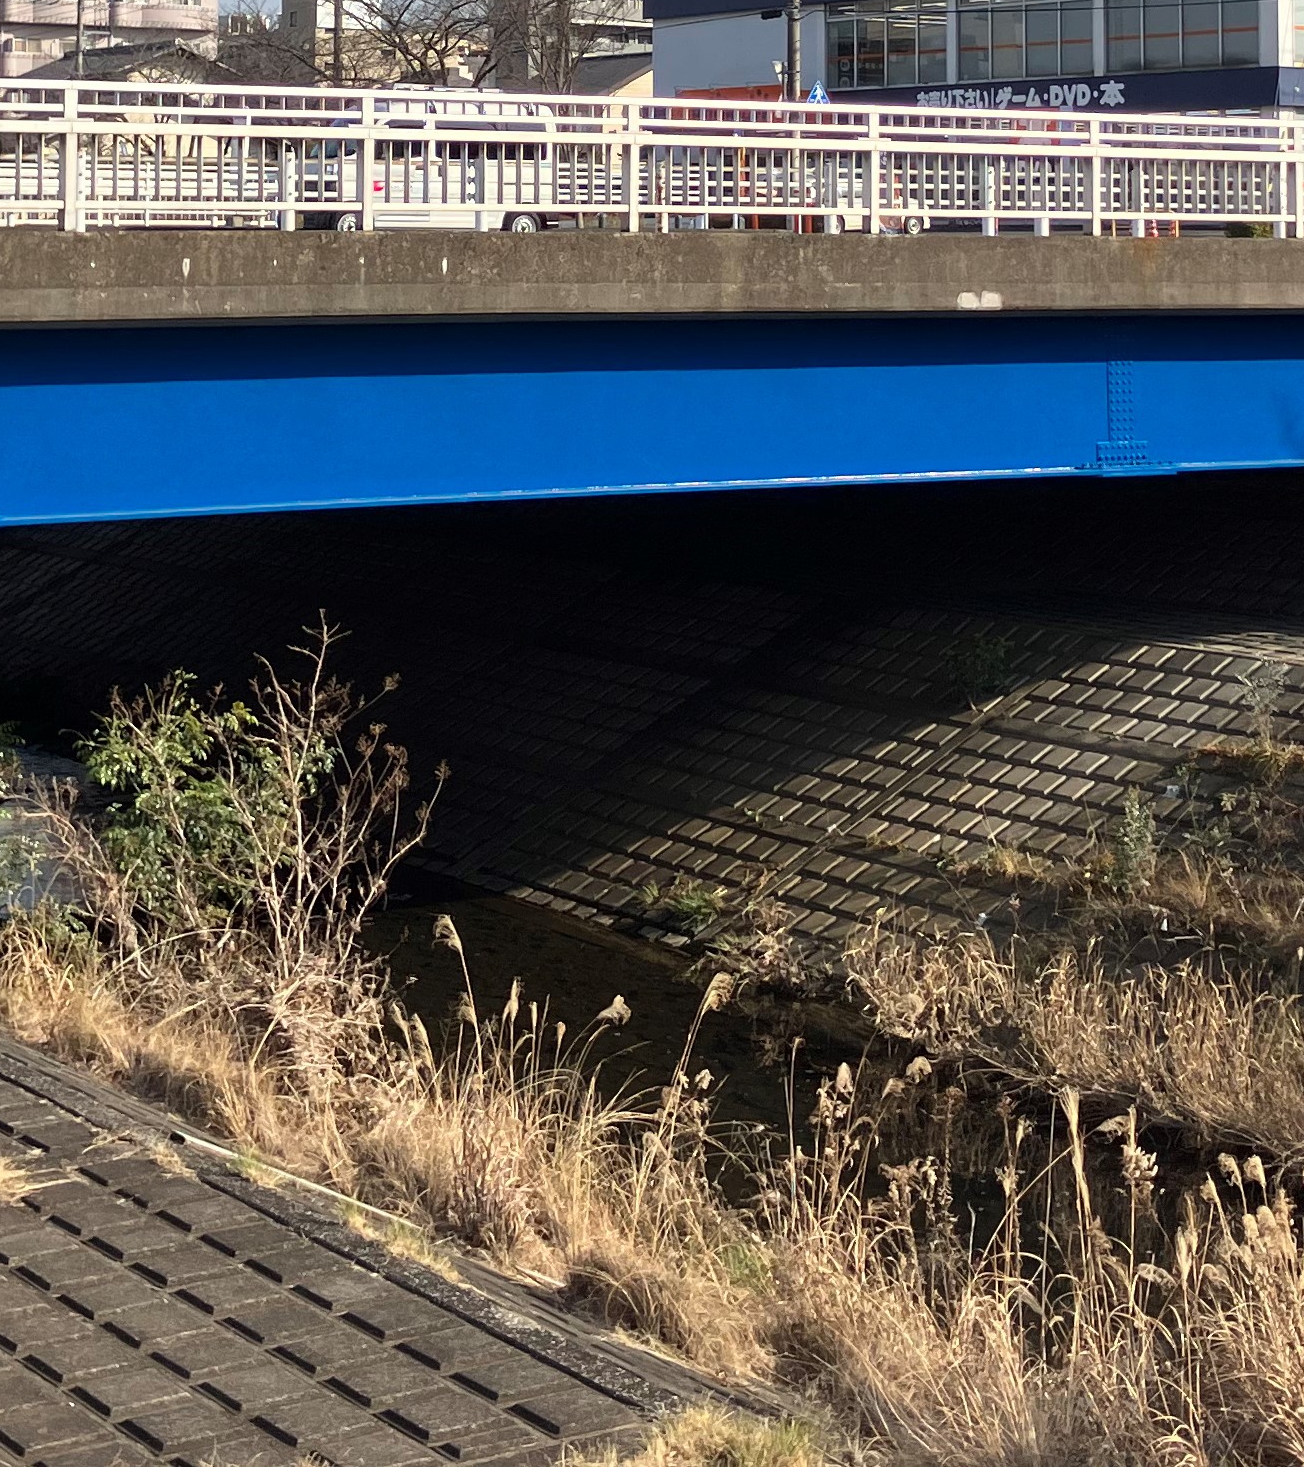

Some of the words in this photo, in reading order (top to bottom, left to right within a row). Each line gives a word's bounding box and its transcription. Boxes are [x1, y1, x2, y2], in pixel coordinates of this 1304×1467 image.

[917, 88, 990, 109] お売り下さい
